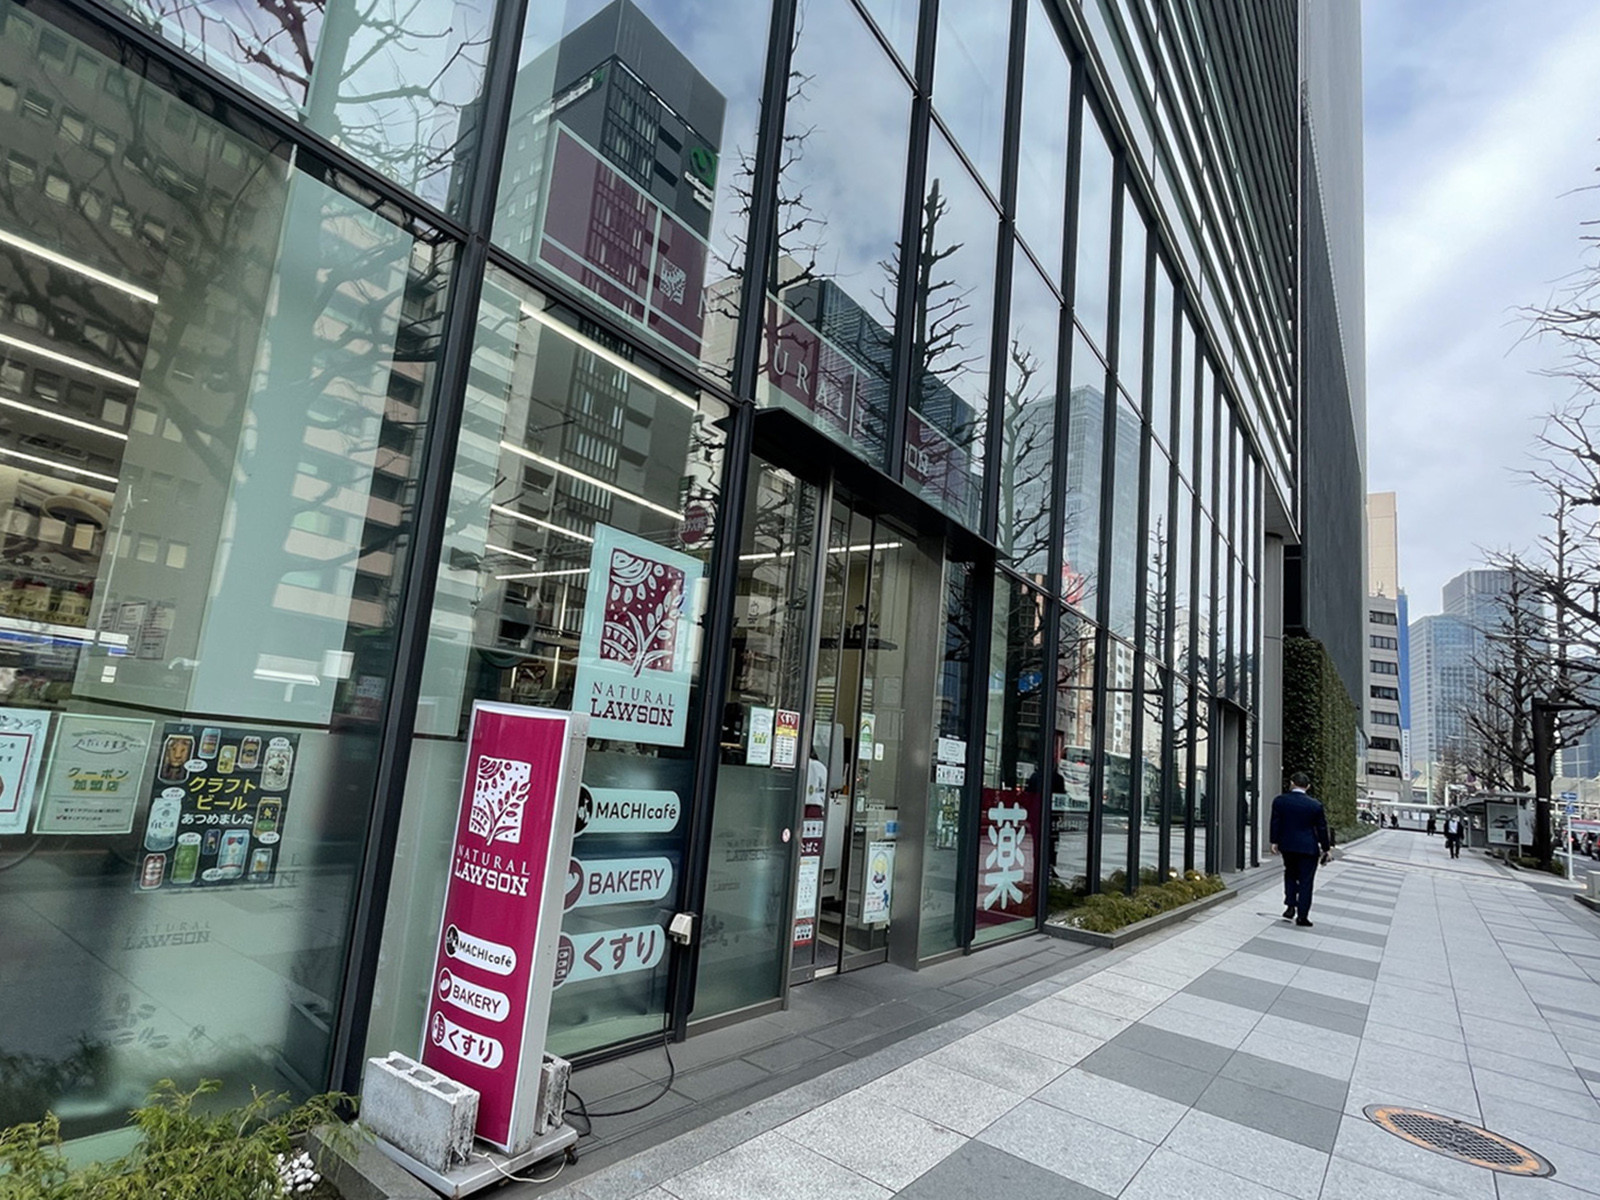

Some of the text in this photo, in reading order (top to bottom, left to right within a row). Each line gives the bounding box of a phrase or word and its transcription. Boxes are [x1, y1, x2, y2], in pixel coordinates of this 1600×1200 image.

[592, 681, 676, 708] NATURAL
[590, 698, 675, 727] LAWSON
[68, 767, 129, 780] クーポン
[72, 780, 119, 792] 加盟店
[188, 776, 257, 794] クラフト
[196, 795, 248, 811] ビール
[596, 801, 677, 820] MACHIcafé
[180, 813, 255, 825] あつめました
[456, 843, 532, 876] NATURAL
[983, 801, 1029, 911] 薬
[454, 858, 530, 898] LAWSON
[588, 867, 665, 896] BAKERY
[123, 930, 211, 951] LAWSON
[583, 929, 656, 972] くすり
[458, 941, 513, 969] MACHIcafé
[453, 984, 502, 1015] BAKERY
[448, 1029, 493, 1063] くすり
